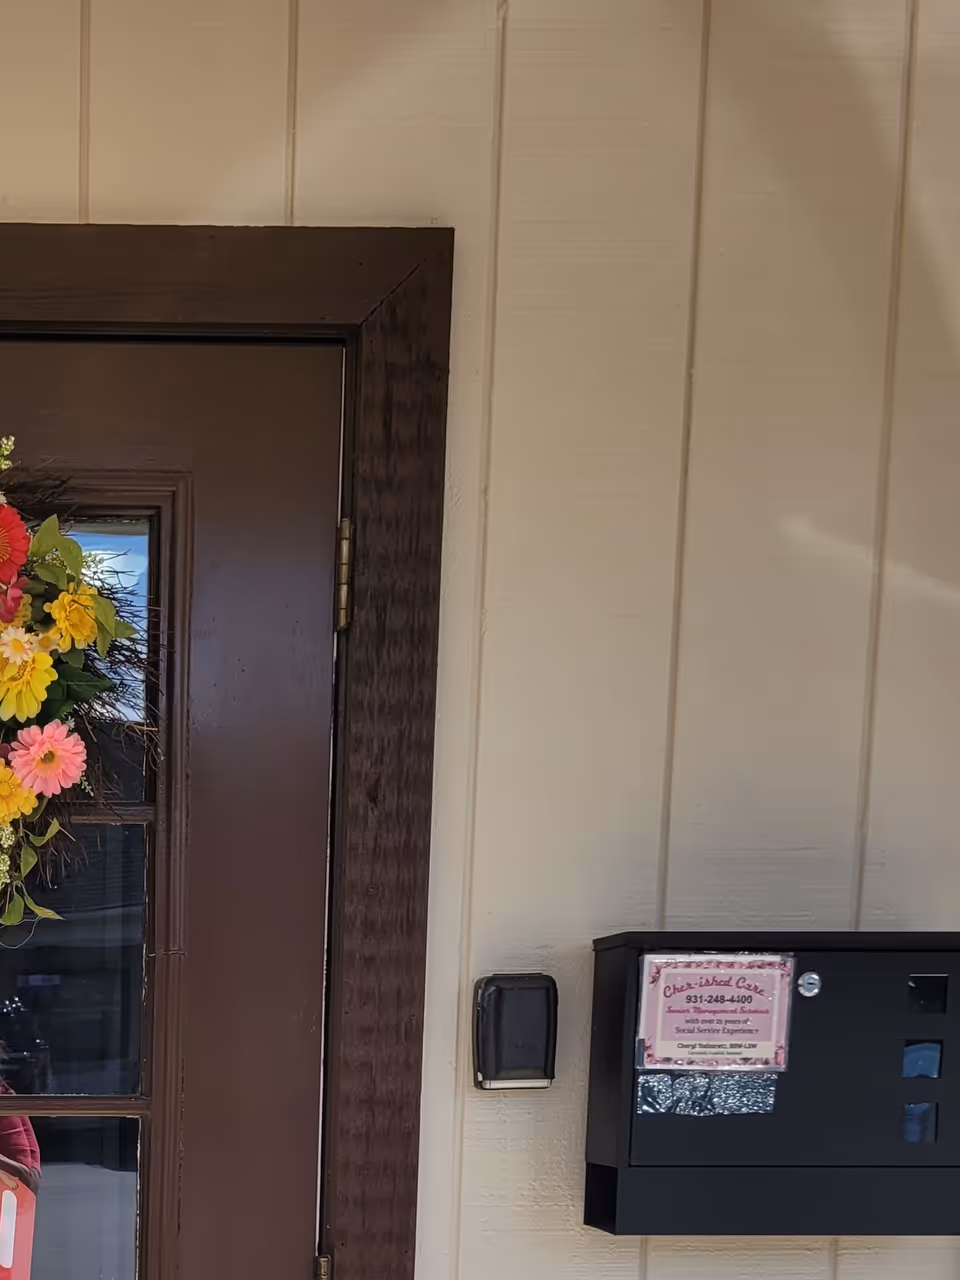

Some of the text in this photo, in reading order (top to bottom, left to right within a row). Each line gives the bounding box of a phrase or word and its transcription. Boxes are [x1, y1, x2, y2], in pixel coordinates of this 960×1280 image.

[663, 976, 765, 998] Cher-ished Care
[675, 1026, 759, 1035] Social Service Experience
